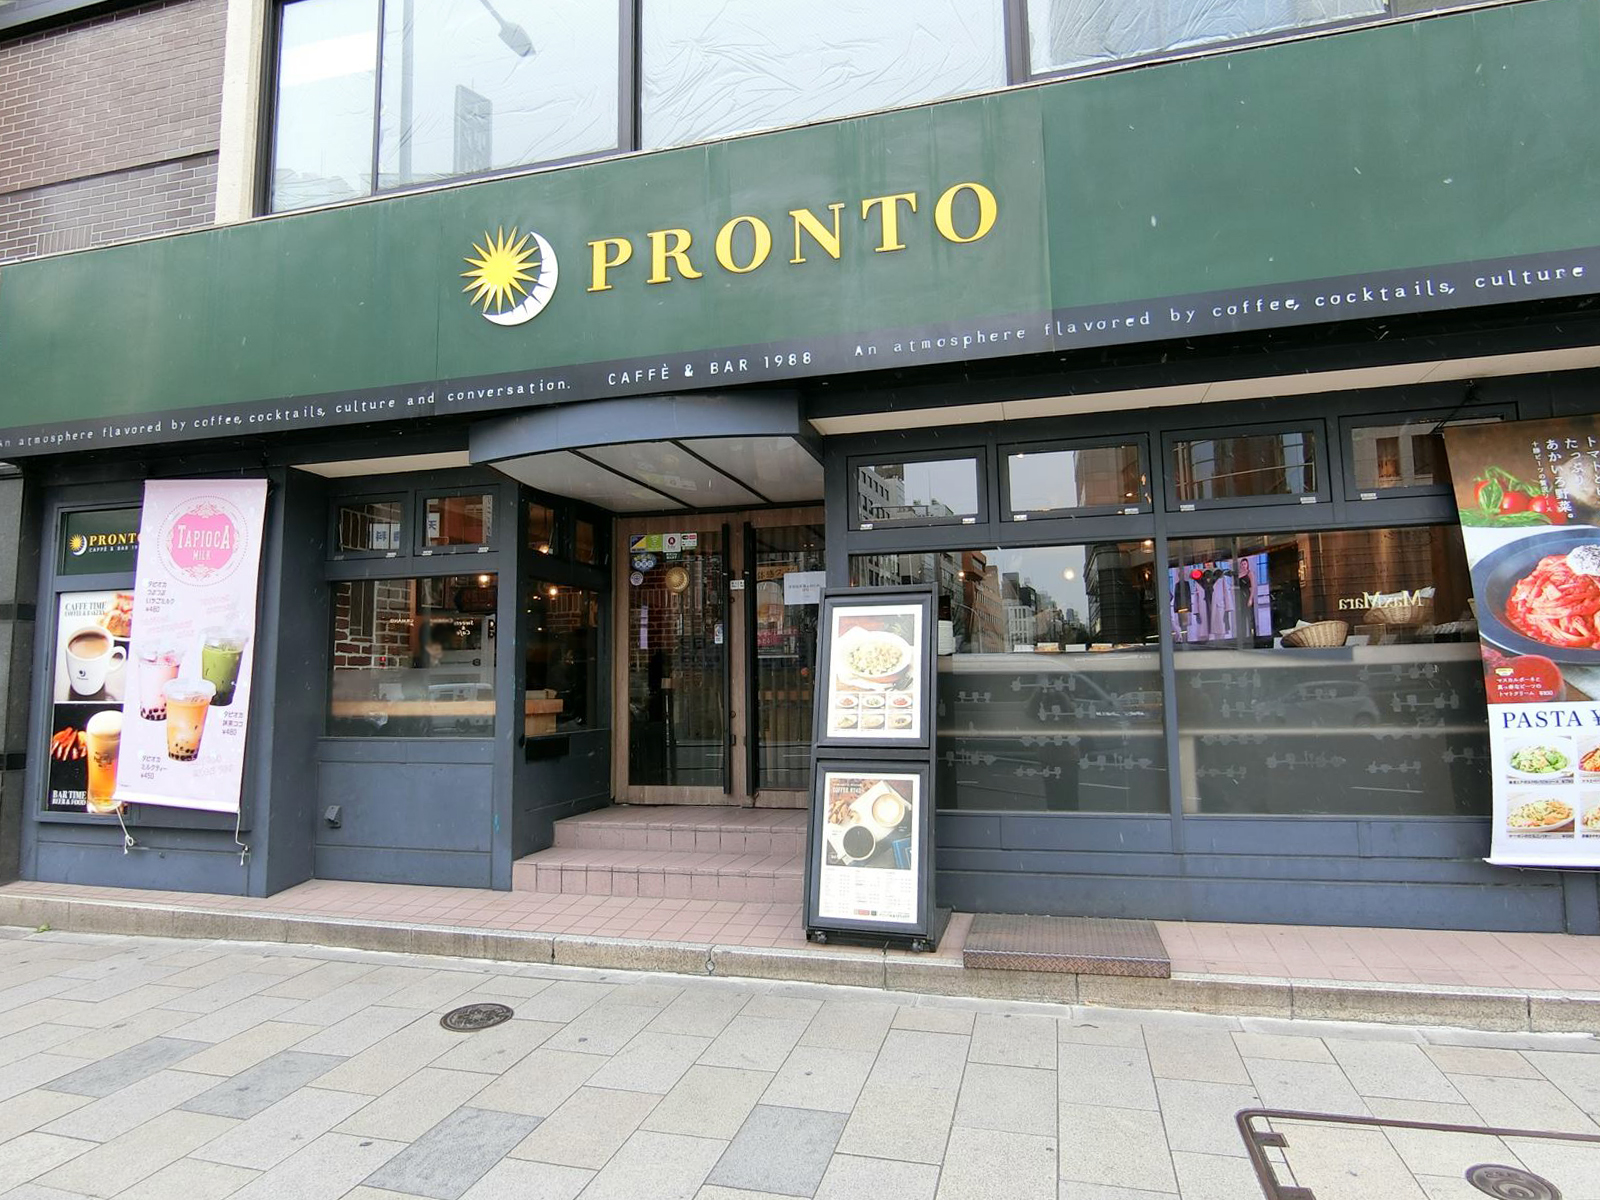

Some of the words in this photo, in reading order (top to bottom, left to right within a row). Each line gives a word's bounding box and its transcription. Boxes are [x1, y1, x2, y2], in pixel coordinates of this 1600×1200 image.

[586, 181, 998, 292] PRONTO
[855, 345, 877, 357] An
[893, 328, 1026, 352] atmosphere
[1044, 311, 1150, 336] flavored
[1170, 308, 1196, 323] by
[1212, 298, 1300, 318] coffee,
[1314, 280, 1455, 307] cocktails,
[1475, 266, 1585, 288] culture
[608, 364, 670, 386] CAFFÈ
[684, 364, 694, 377] &
[709, 358, 748, 375] BAR
[763, 351, 813, 369] 1988
[18, 430, 94, 447] atmosphere
[103, 421, 162, 438] flavored
[171, 419, 187, 432] by
[194, 414, 243, 428] coffee,
[249, 405, 326, 423] cocktails,
[335, 399, 396, 413] culture
[407, 393, 435, 406] and
[447, 379, 571, 401] conversation.
[89, 533, 138, 546] PRONT
[178, 525, 230, 549] TAPIOCA
[193, 550, 211, 561] MILK
[1502, 710, 1583, 729] PASTA
[53, 789, 68, 799] BAR
[68, 790, 87, 800] TIME
